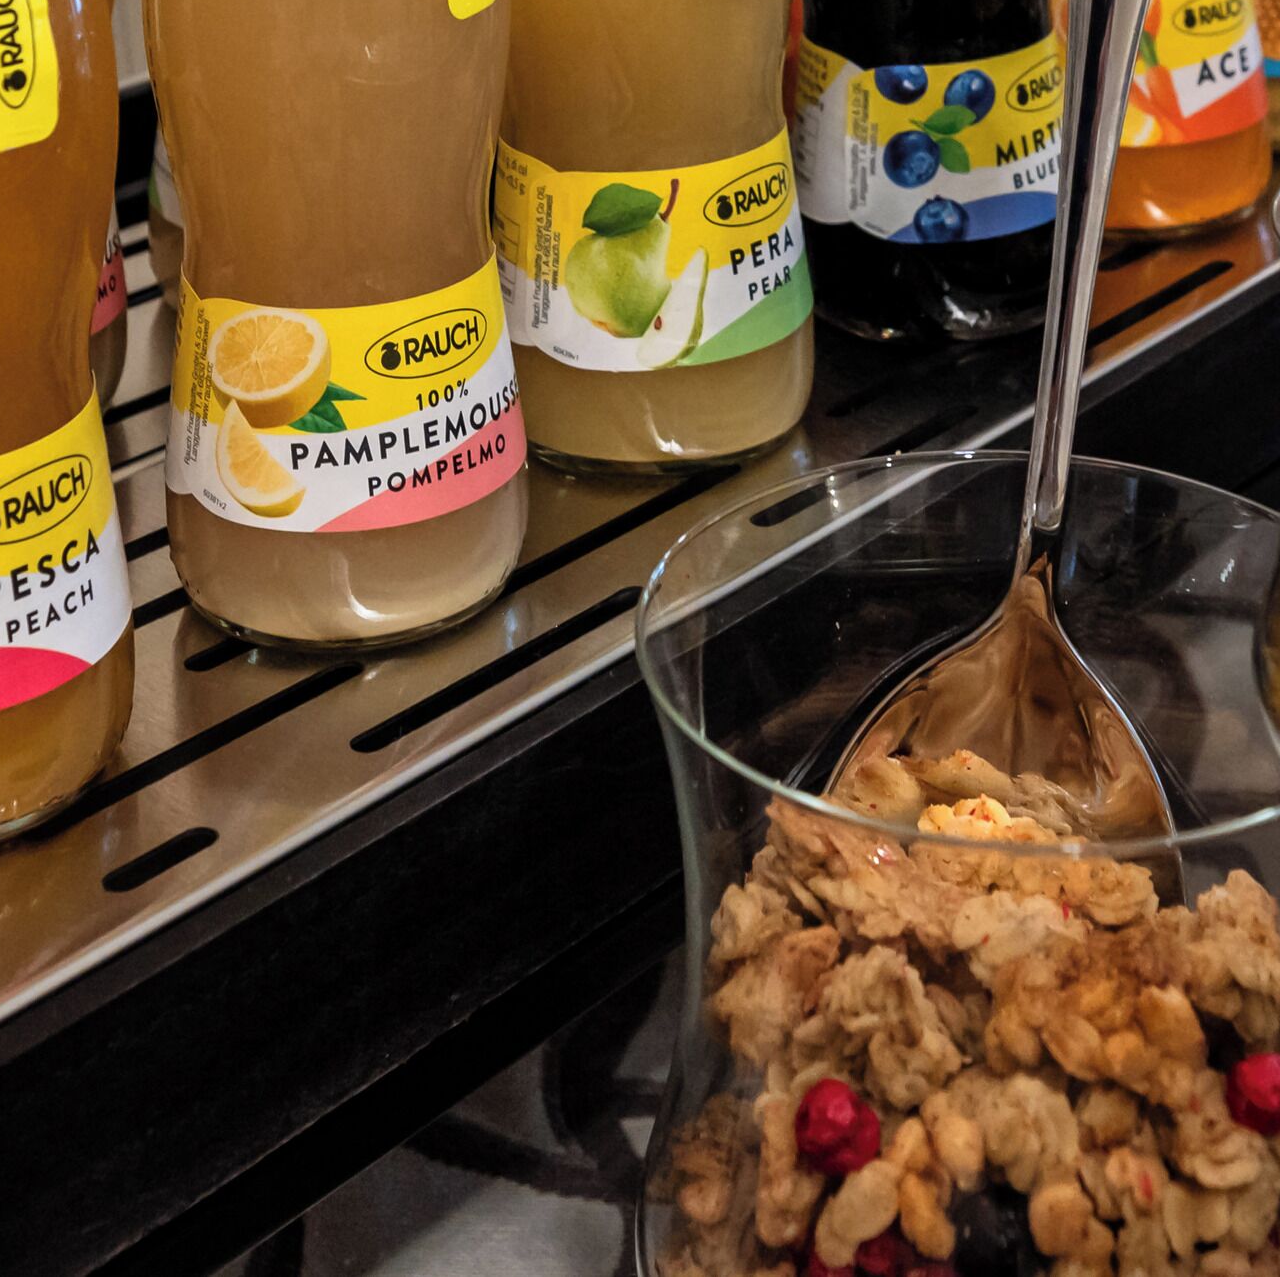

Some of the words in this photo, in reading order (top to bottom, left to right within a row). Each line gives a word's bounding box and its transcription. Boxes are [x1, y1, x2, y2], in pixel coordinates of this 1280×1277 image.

[1030, 66, 1062, 100] RAUC
[1197, 47, 1249, 85] ACE
[995, 117, 1062, 166] MIRTI
[734, 169, 787, 215] RAUCH
[1013, 154, 1060, 189] BLUE
[730, 226, 794, 275] PERA
[748, 265, 792, 301] PEAR
[403, 316, 479, 365] RAUCH
[415, 378, 469, 411] 100%
[184, 434, 194, 465] Rauch
[368, 434, 506, 497] POMPELMO
[3, 462, 85, 529] RAUCH
[6, 579, 94, 643] PEACH
